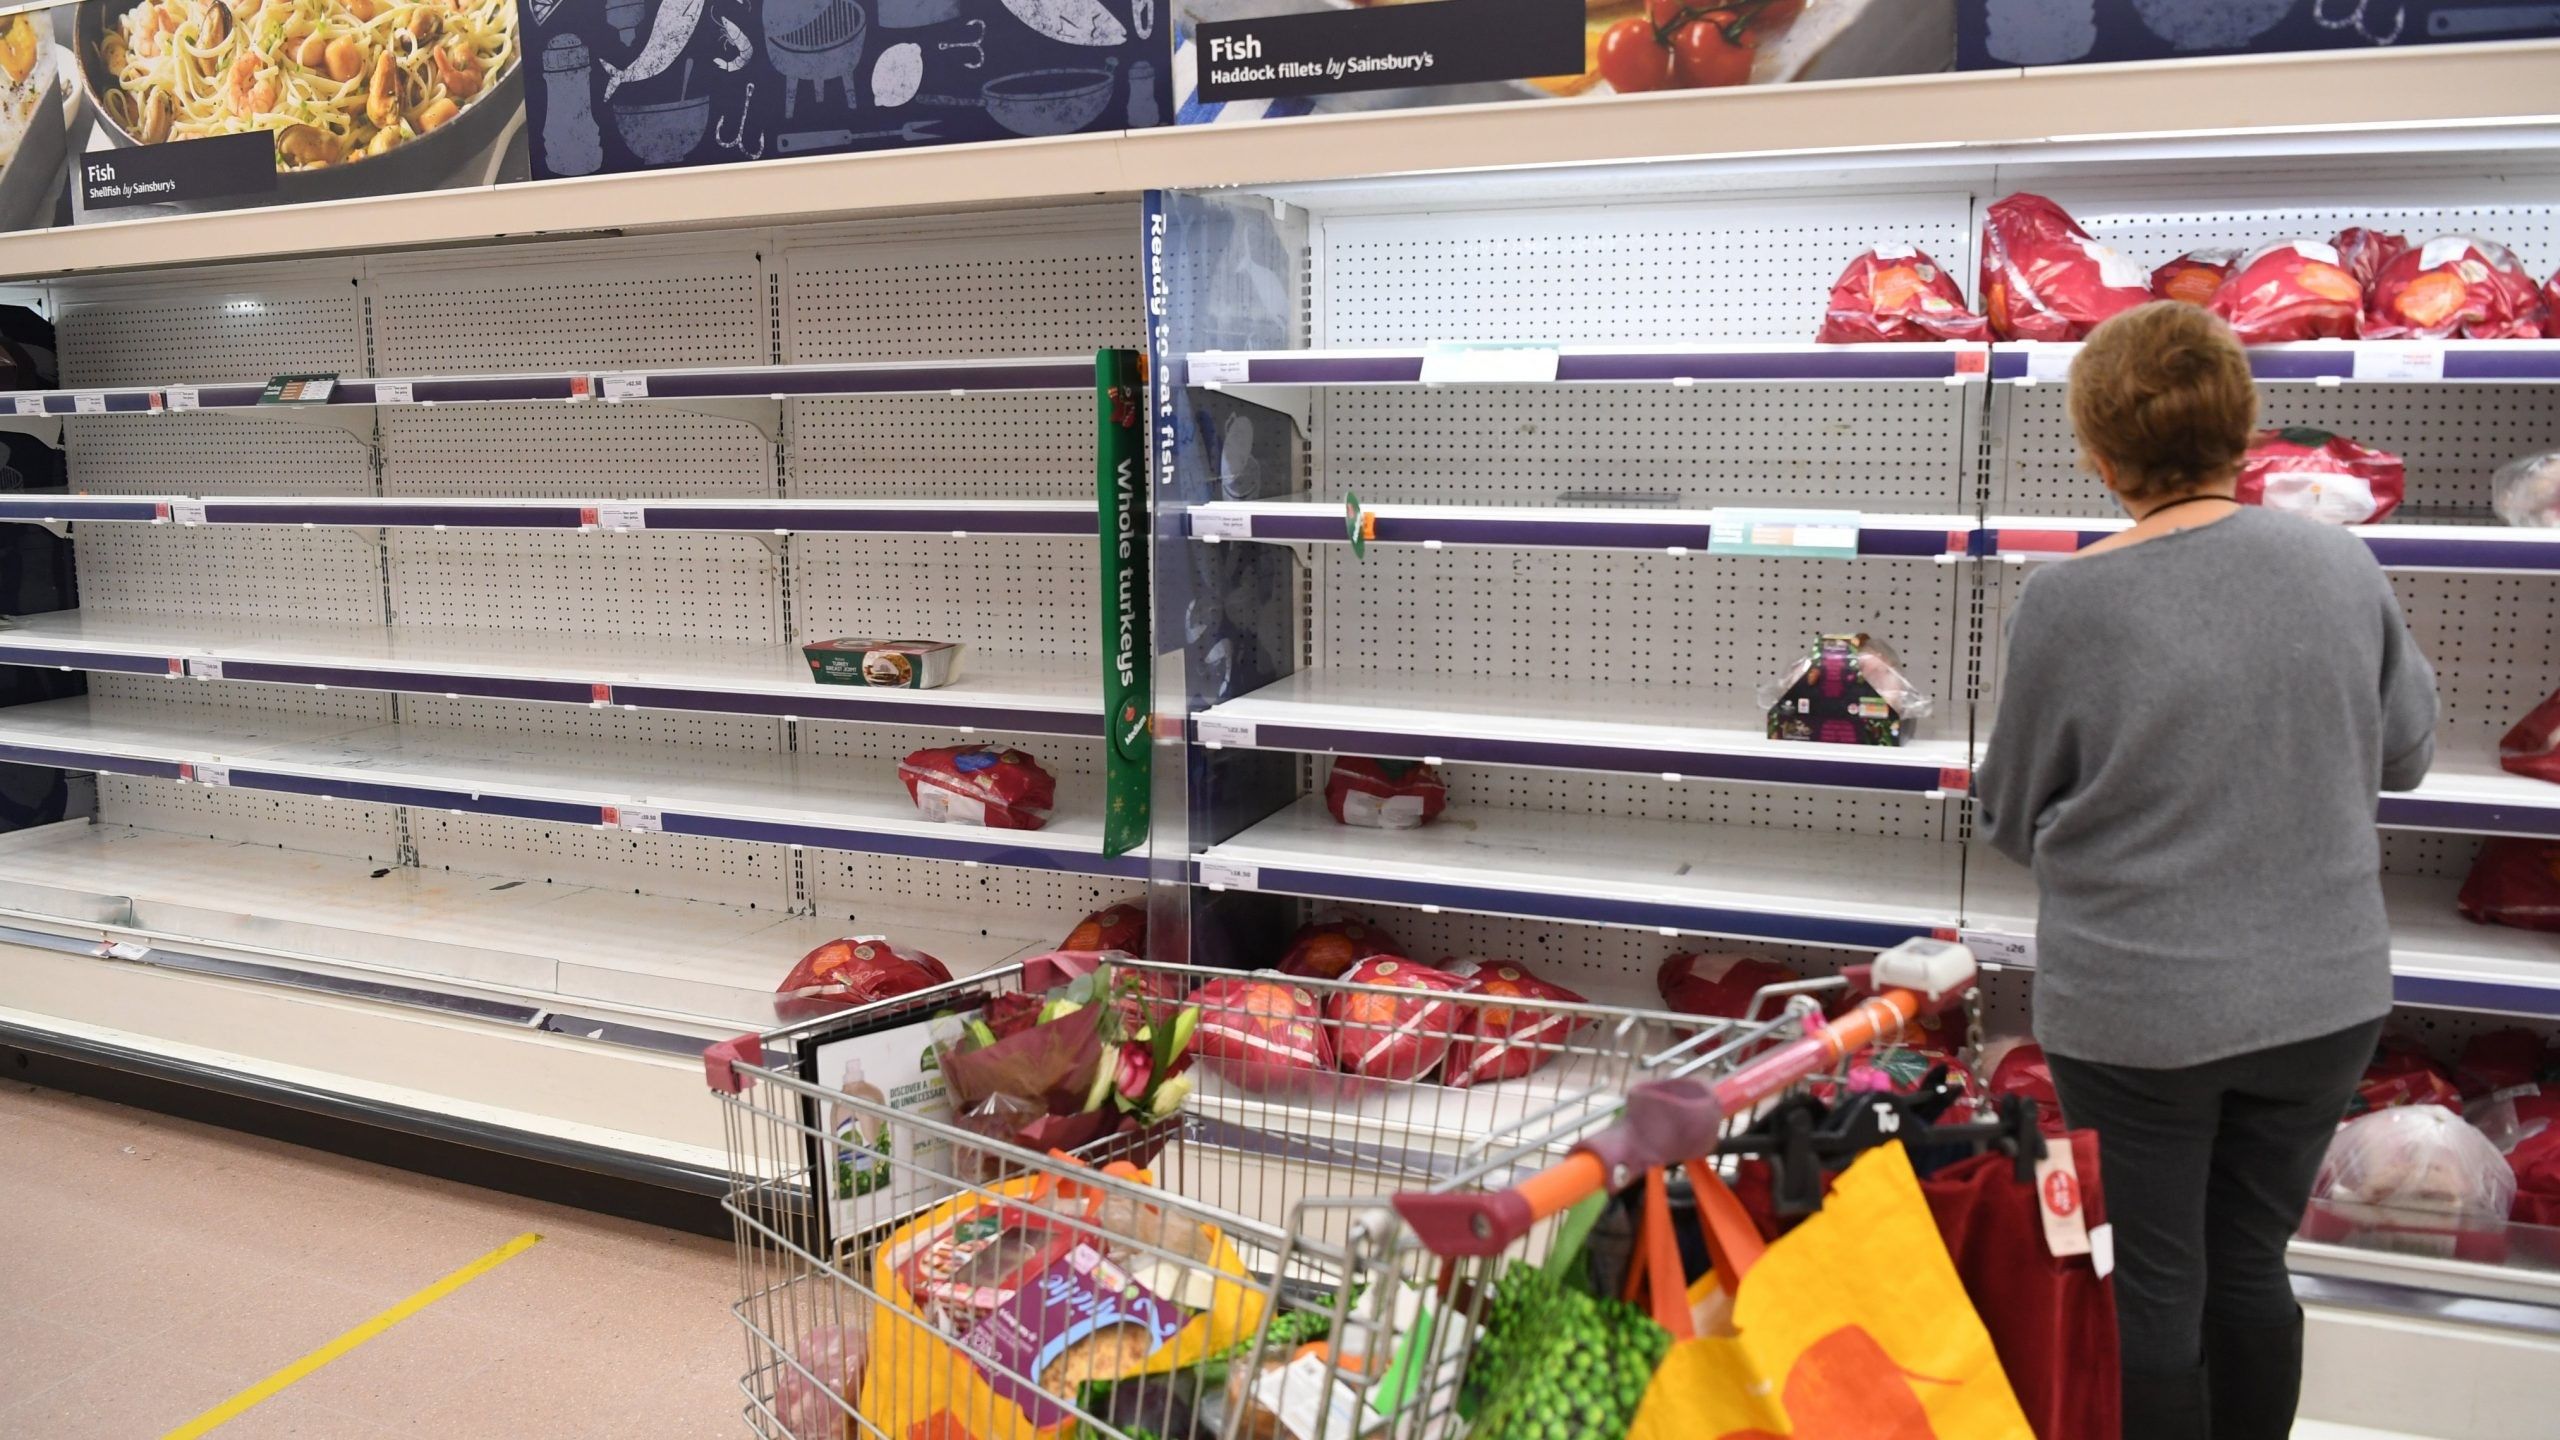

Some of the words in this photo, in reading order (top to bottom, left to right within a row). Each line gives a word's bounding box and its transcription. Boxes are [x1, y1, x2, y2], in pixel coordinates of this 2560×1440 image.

[1209, 34, 1262, 62] Fish
[1210, 64, 1276, 84] Haddock
[1277, 61, 1323, 79] fillets
[1325, 57, 1346, 80] by
[1347, 51, 1434, 73] Sainsbury's
[88, 163, 116, 182] Fish
[89, 185, 121, 199] Shellfish
[123, 183, 133, 199] by
[133, 179, 176, 194] Sainsbury's
[1150, 213, 1169, 316] Ready
[1155, 323, 1169, 358] to
[1160, 365, 1173, 418] eat
[1161, 424, 1175, 485] fish
[1117, 458, 1134, 559] Whole
[1116, 566, 1135, 687] turkeys
[890, 1081, 922, 1098] DISCOVER
[923, 1080, 928, 1089] A
[901, 1087, 947, 1107] UNNECESSARY
